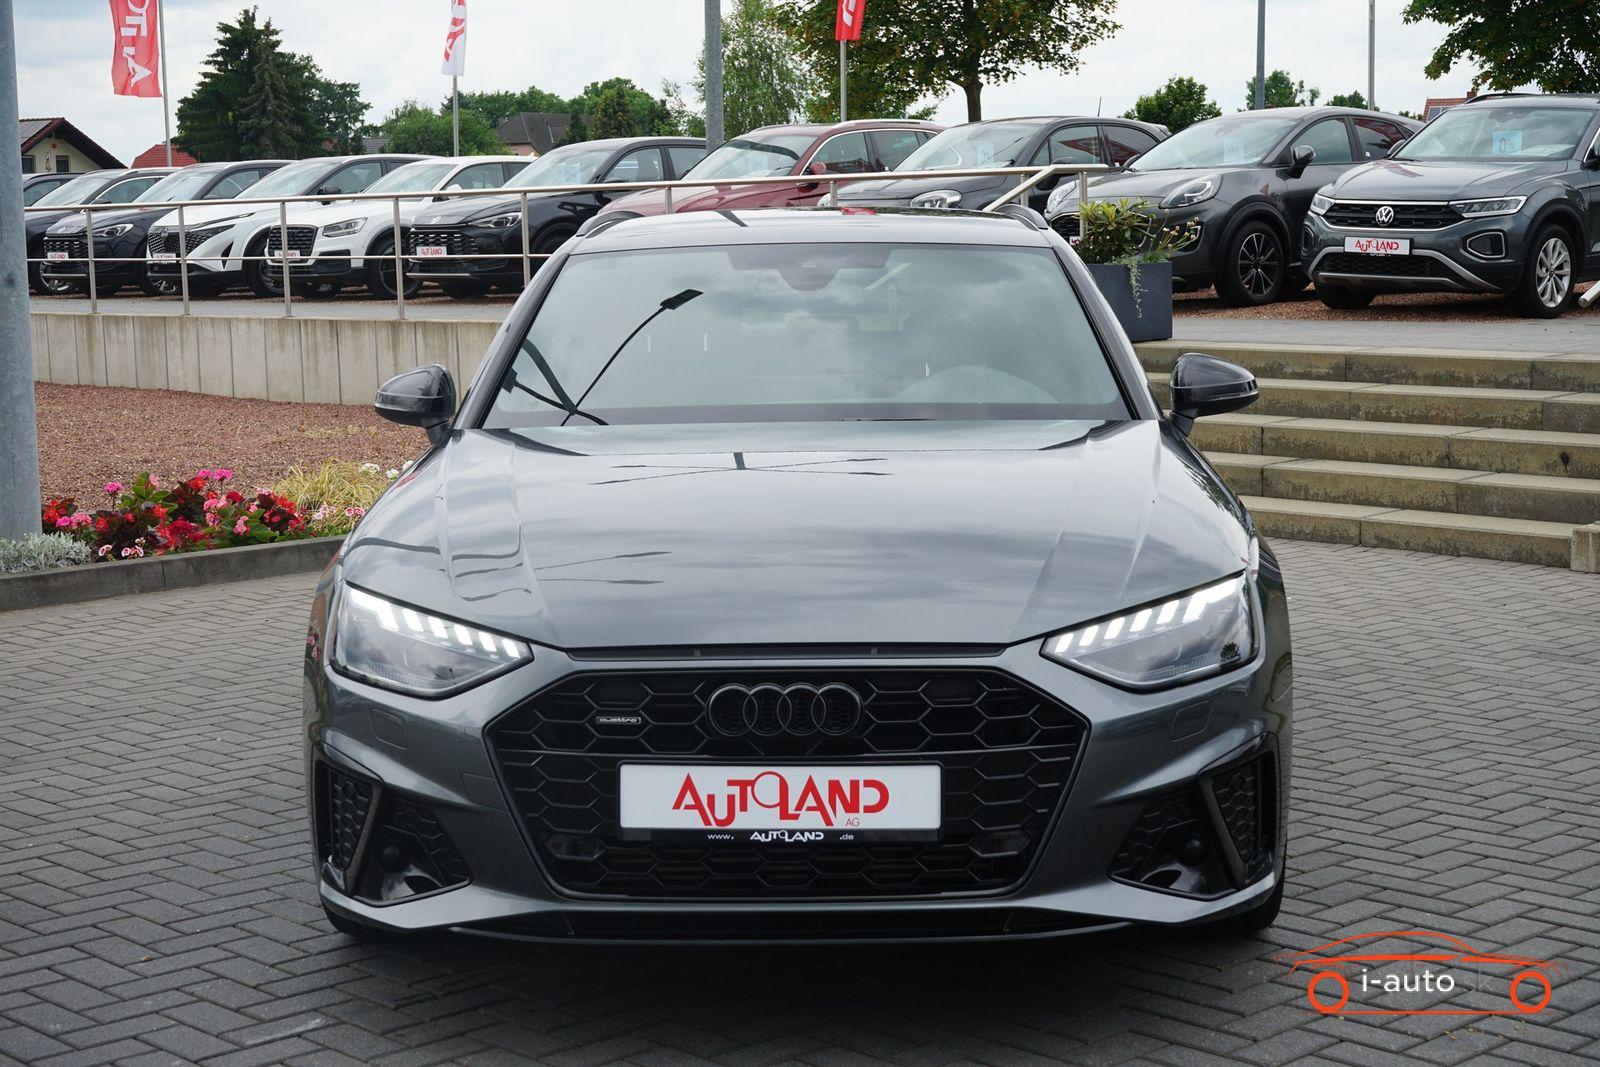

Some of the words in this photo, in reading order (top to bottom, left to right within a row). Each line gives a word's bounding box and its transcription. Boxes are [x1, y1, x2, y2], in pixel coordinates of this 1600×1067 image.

[1355, 239, 1400, 252] AUTOLAND
[672, 771, 890, 827] AUTOLAND
[845, 818, 860, 827] AG
[750, 830, 825, 842] AUTOLAND
